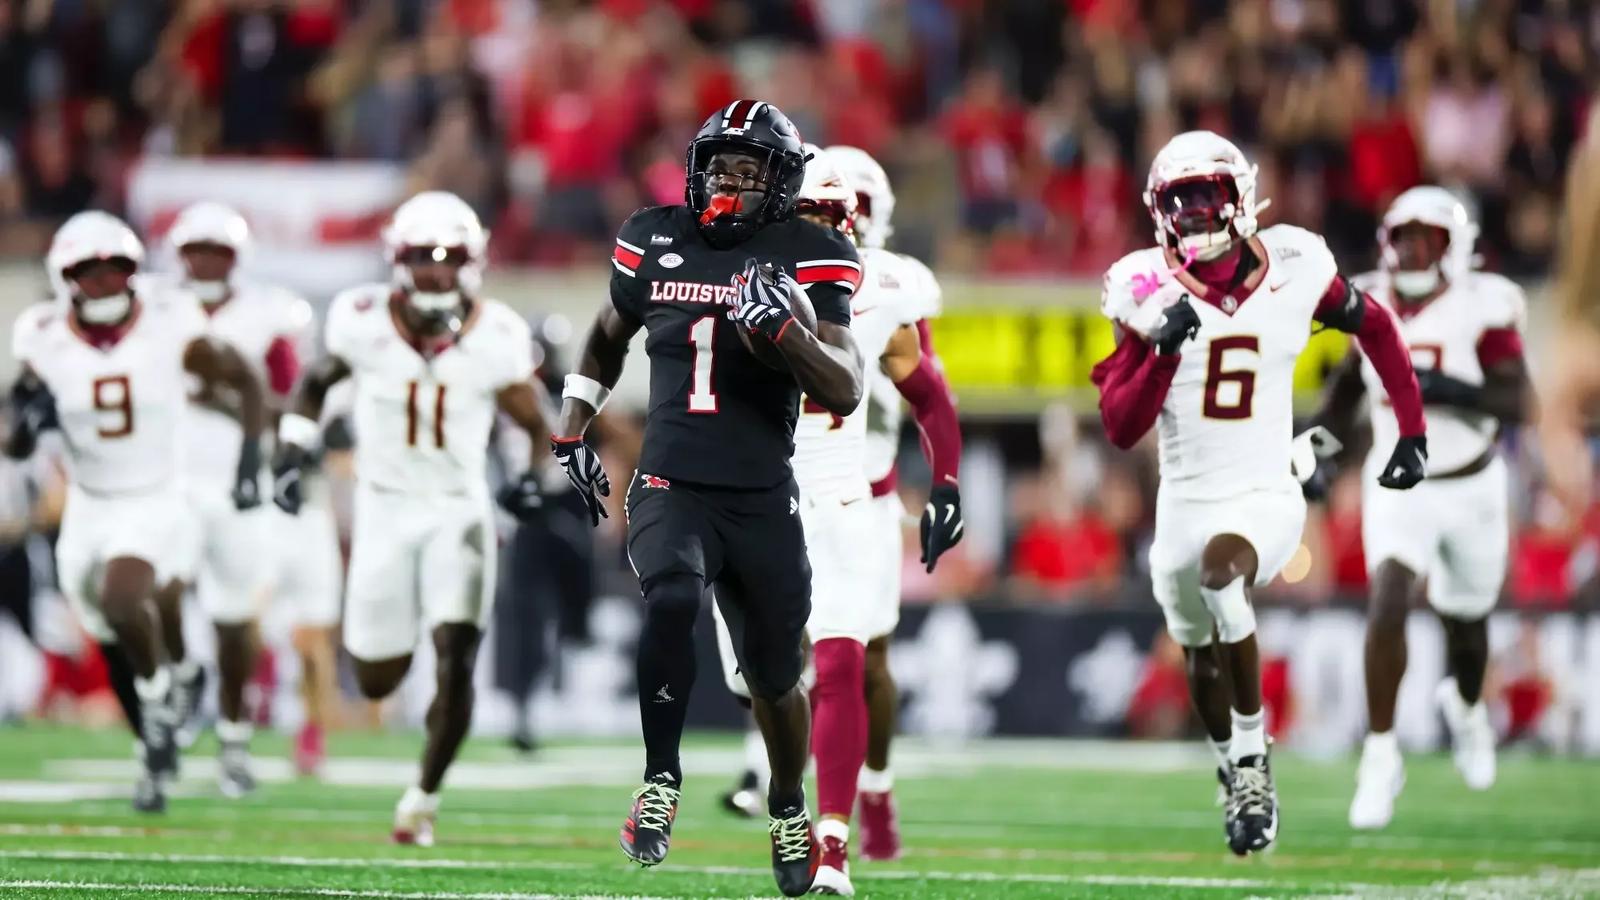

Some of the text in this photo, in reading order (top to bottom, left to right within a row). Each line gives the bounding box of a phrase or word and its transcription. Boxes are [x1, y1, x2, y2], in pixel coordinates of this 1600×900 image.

[688, 314, 719, 413] 1
[1203, 334, 1261, 421] 6
[92, 375, 134, 440] 9
[407, 381, 446, 449] 11
